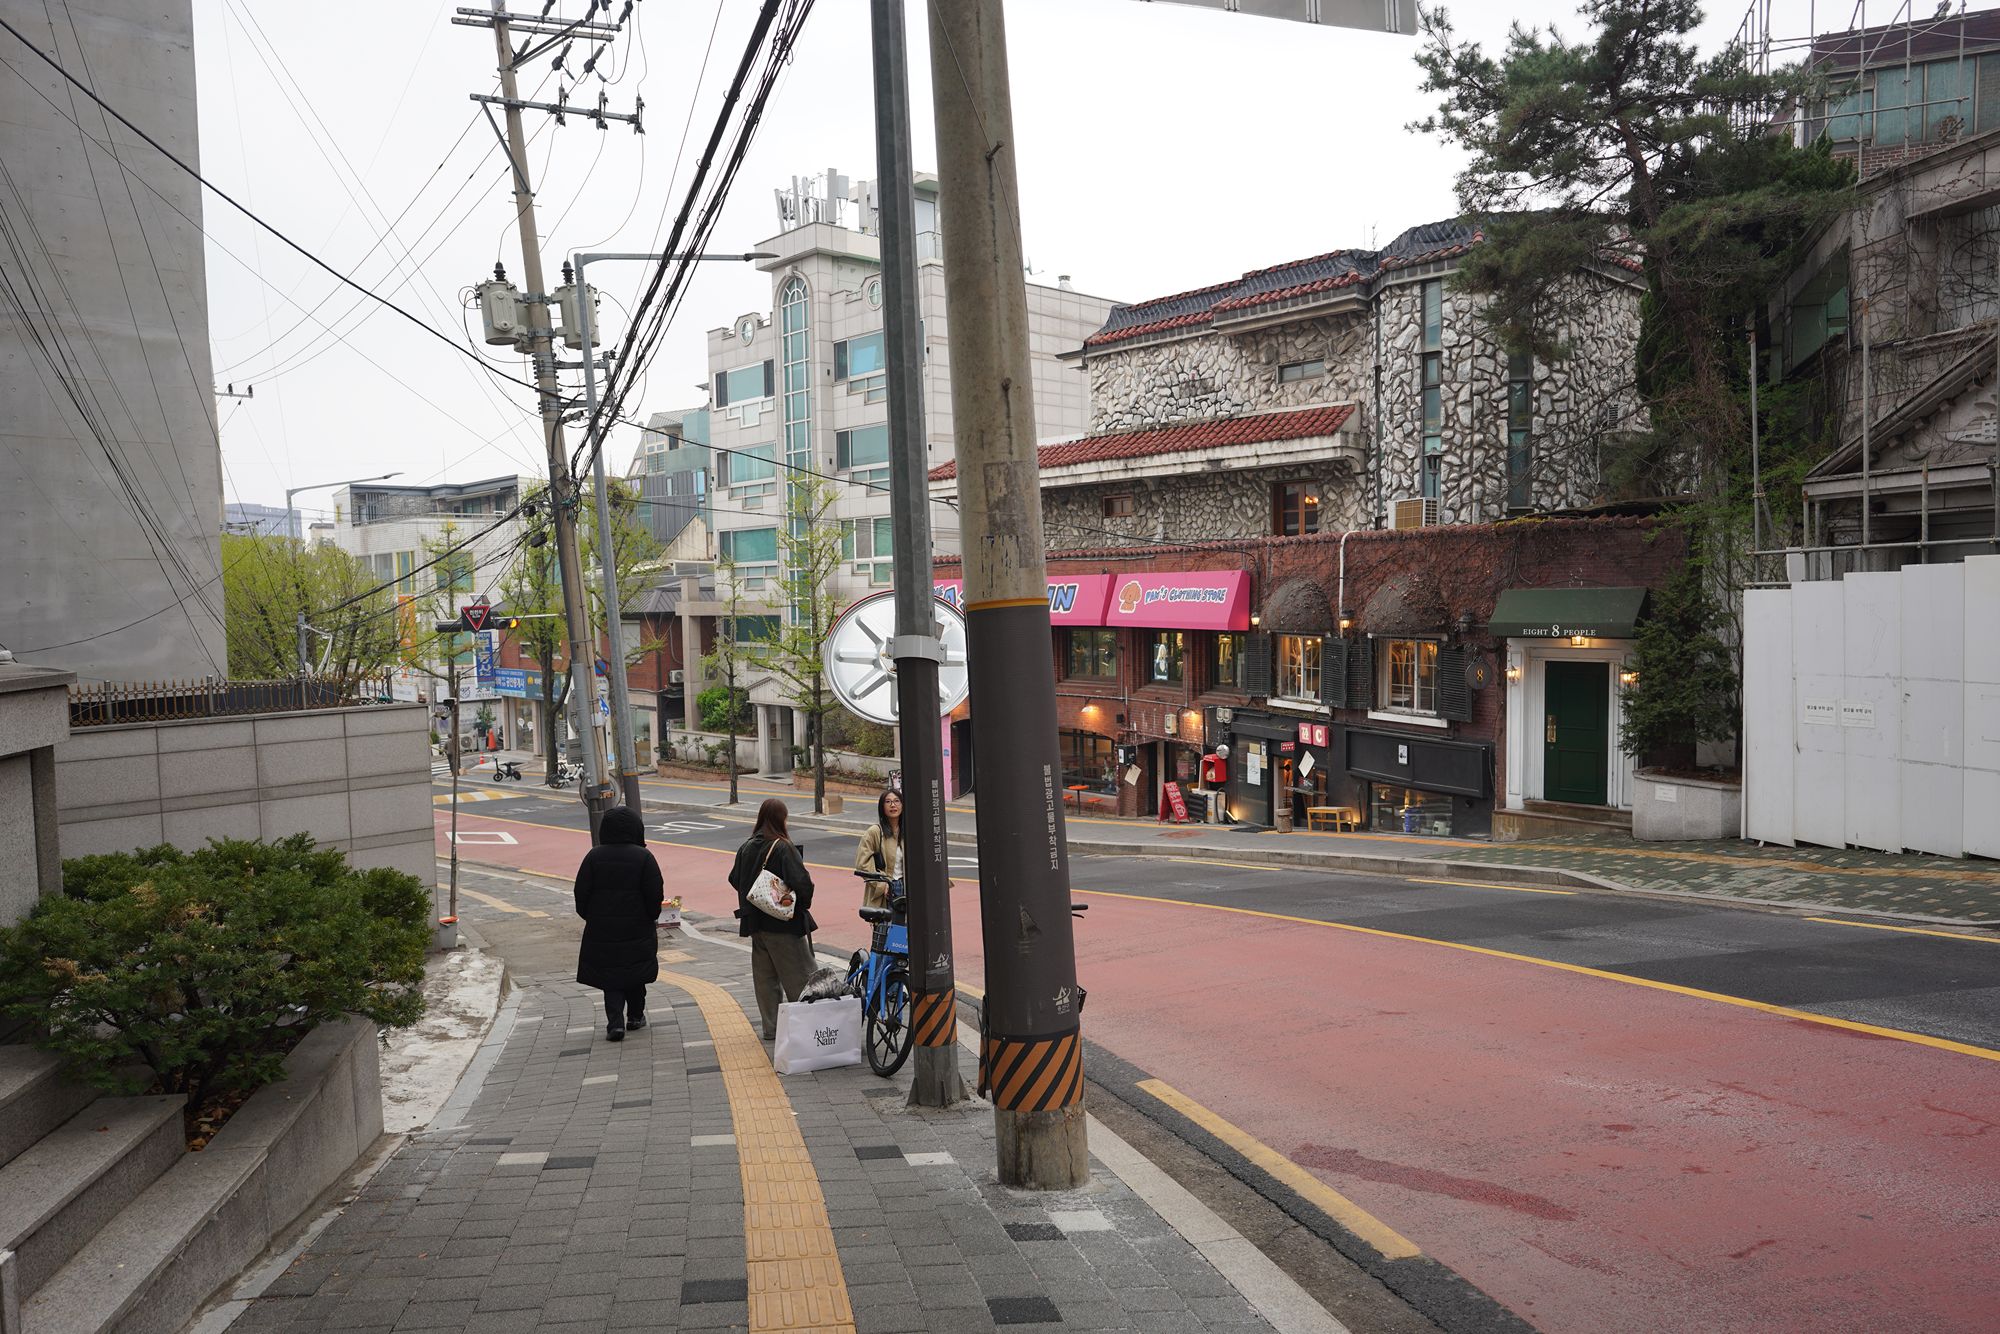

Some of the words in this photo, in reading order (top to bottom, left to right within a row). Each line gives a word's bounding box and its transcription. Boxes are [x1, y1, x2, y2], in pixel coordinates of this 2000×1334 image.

[1168, 588, 1202, 602] CLOTHING
[1201, 588, 1227, 604] STORE
[1522, 628, 1548, 636] EIGHT
[1551, 624, 1560, 637] 8
[813, 1026, 839, 1039] Atelier
